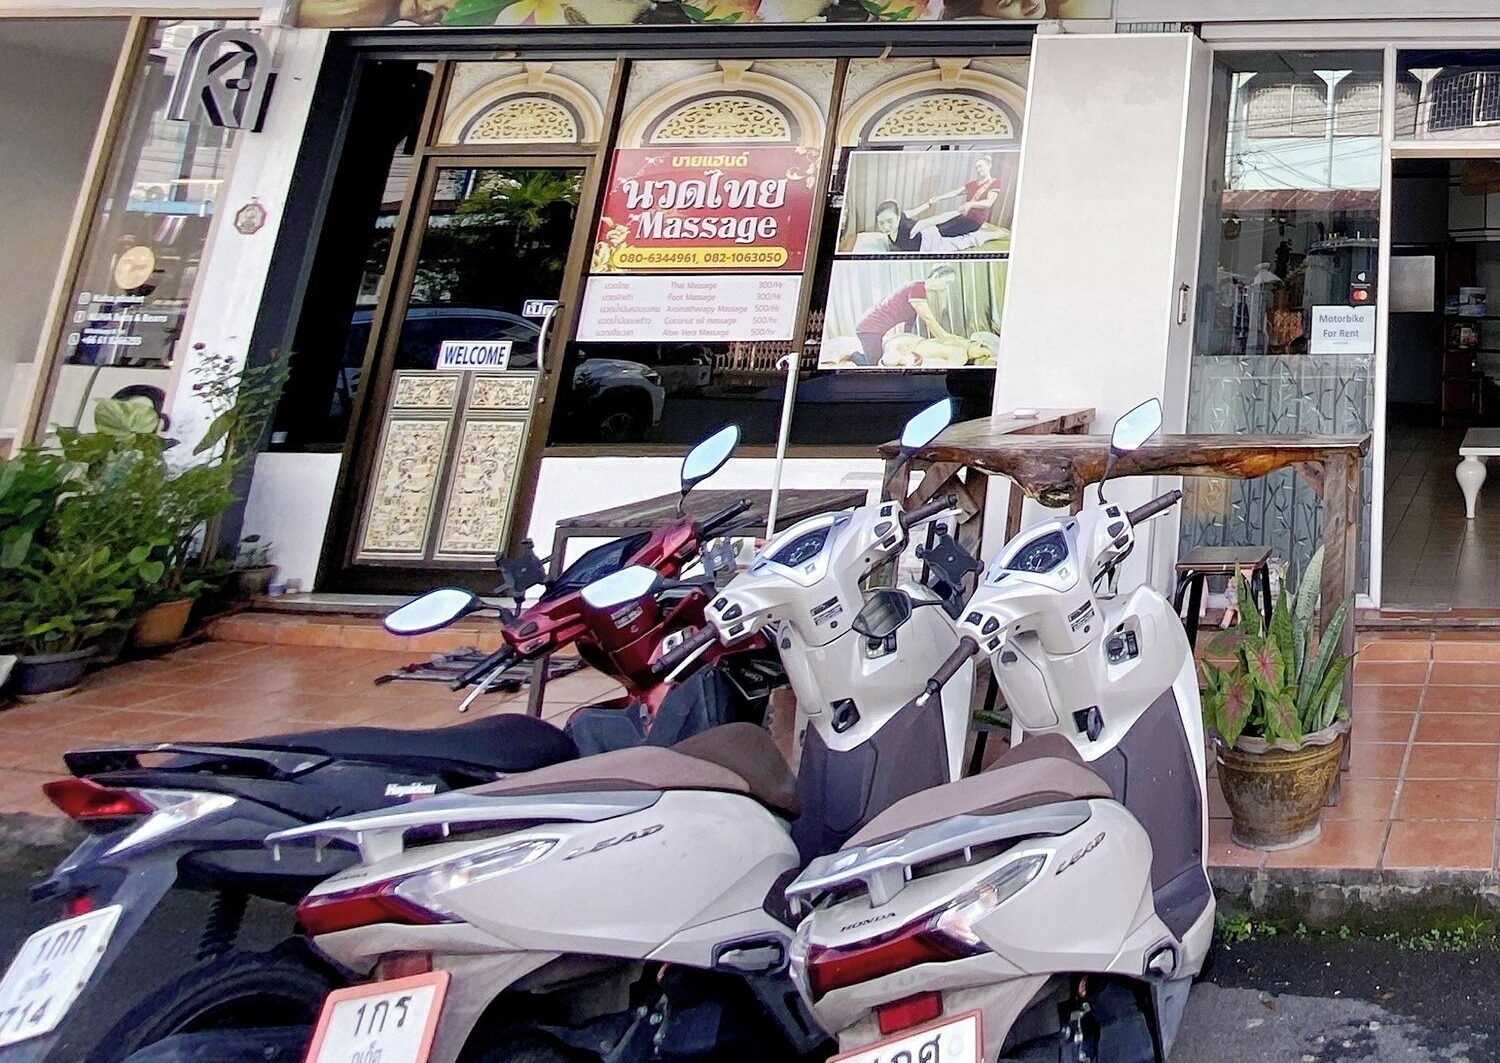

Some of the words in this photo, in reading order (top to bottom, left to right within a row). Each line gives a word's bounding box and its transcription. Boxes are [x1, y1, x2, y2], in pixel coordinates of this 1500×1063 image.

[621, 168, 789, 210] นวดไทย
[634, 211, 778, 245] Massage
[703, 252, 782, 263] 082-1063050
[1319, 314, 1365, 323] Motorbike
[1323, 329, 1337, 338] For
[1339, 329, 1359, 338] Rent
[444, 345, 506, 365] WELCOME
[1054, 831, 1106, 877] LEAD
[840, 912, 896, 933] HONDA
[0, 995, 54, 1032] 714
